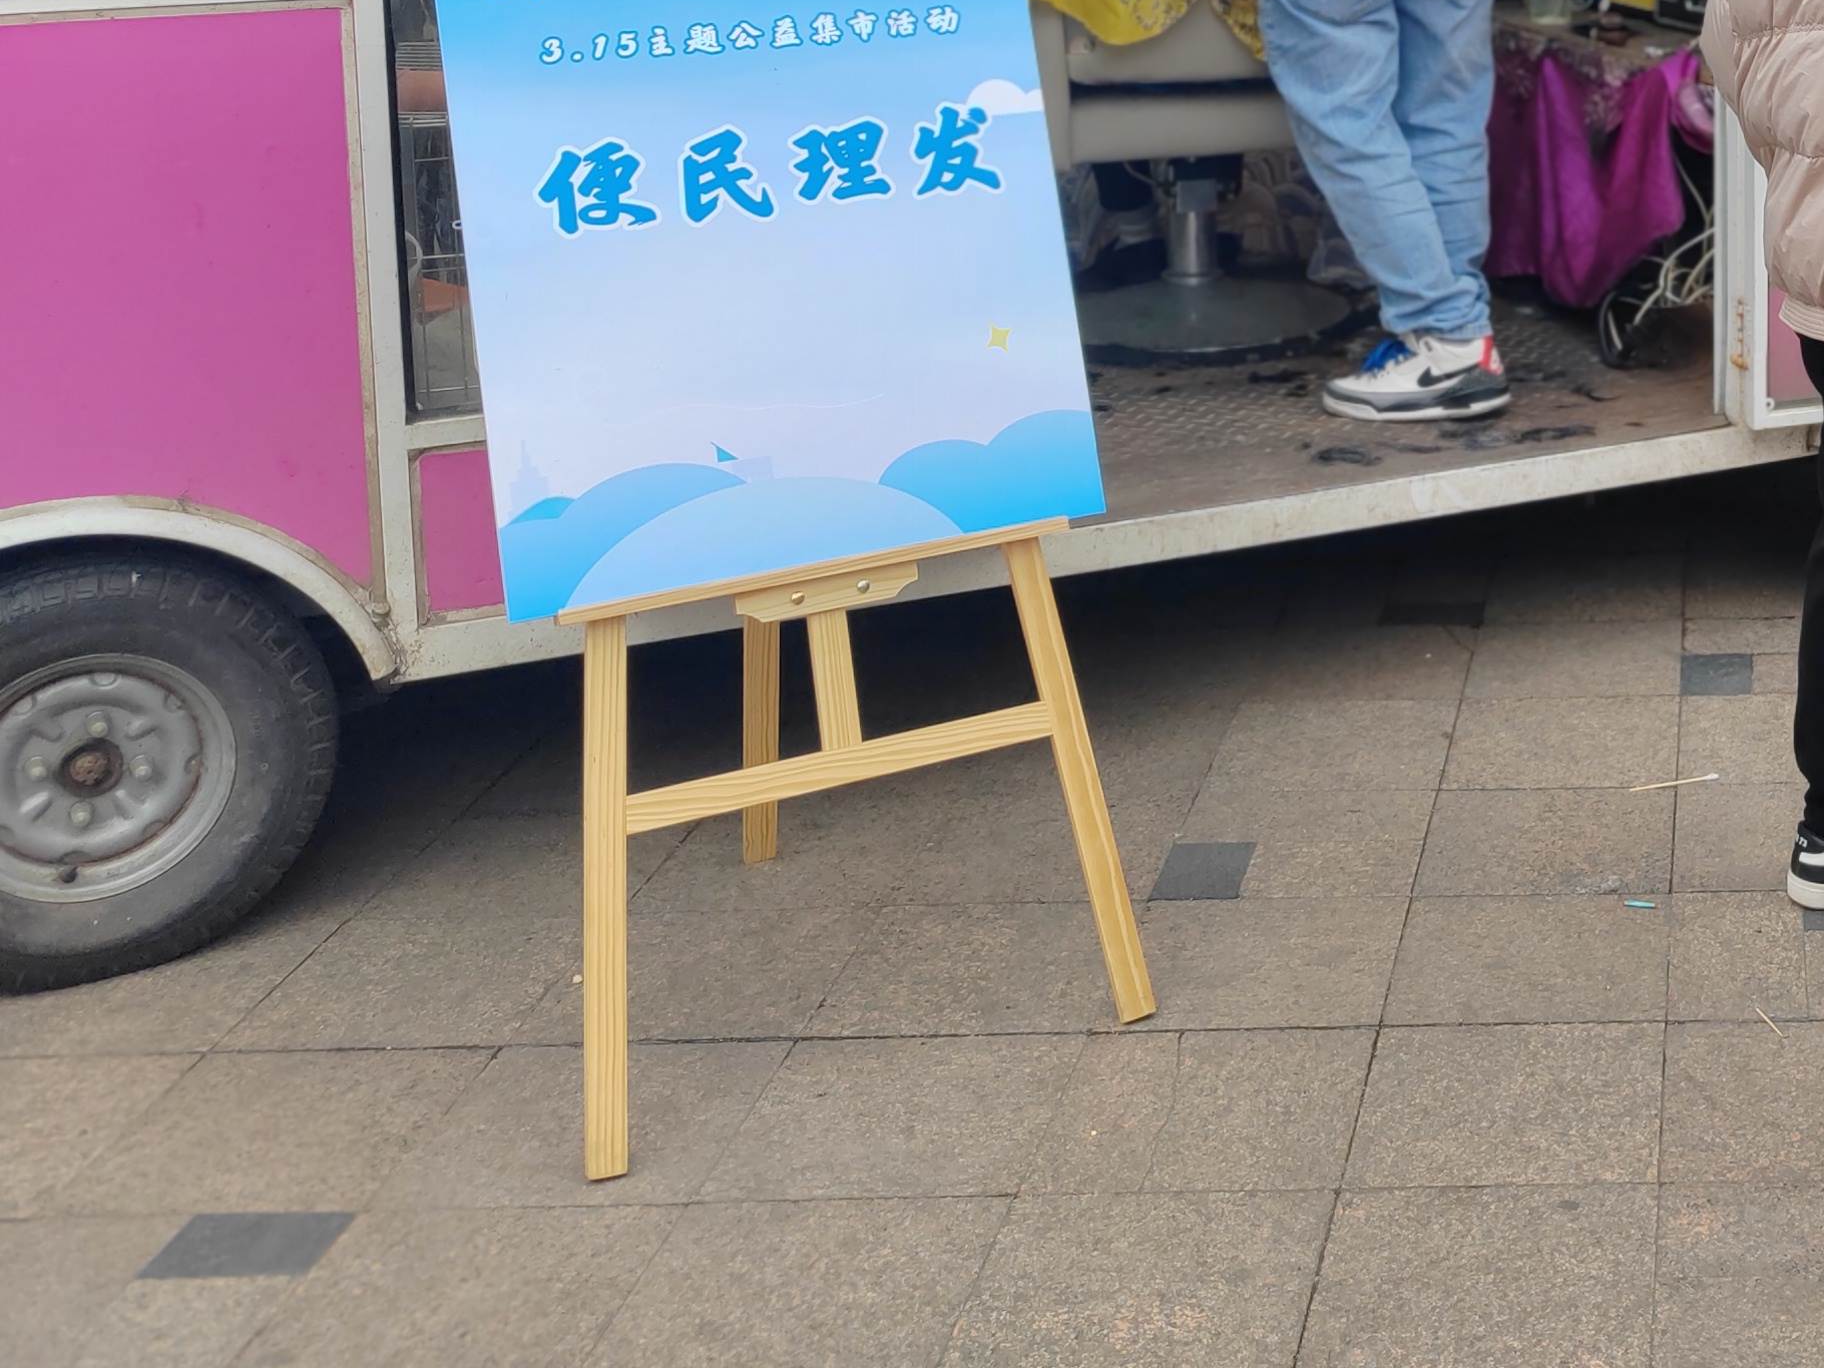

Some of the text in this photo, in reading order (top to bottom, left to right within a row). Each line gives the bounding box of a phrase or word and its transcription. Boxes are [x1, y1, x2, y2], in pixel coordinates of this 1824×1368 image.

[539, 4, 961, 65] 3.15主题公益集市活动
[534, 104, 1003, 238] 便民理发
